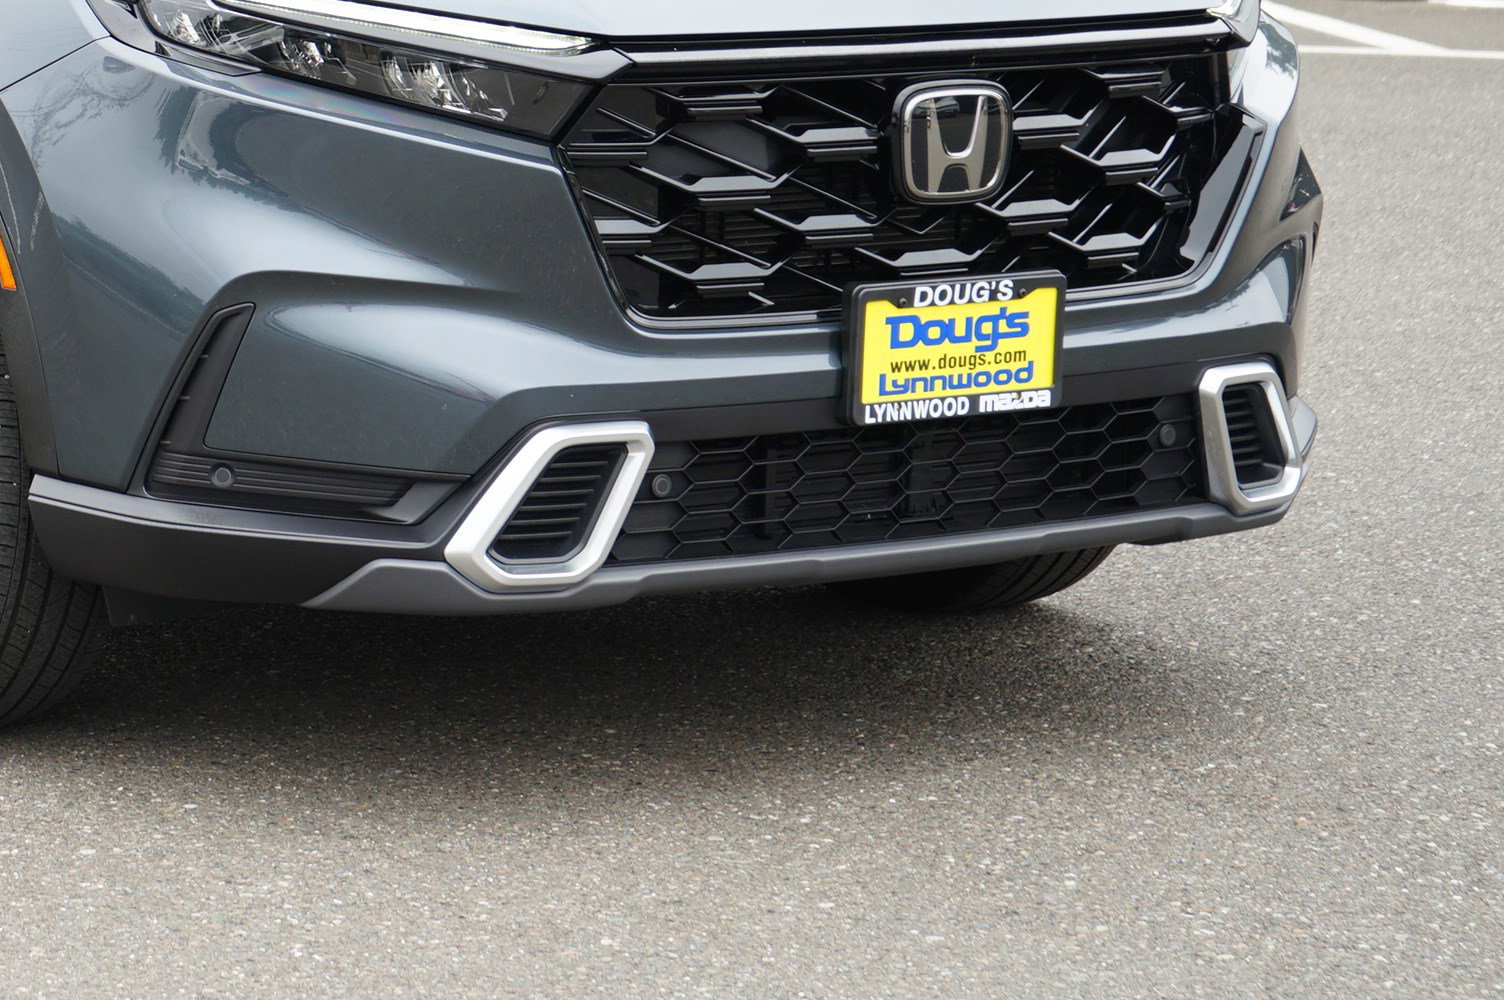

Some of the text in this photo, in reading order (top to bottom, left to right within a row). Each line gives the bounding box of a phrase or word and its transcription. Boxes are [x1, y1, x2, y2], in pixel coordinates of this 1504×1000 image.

[913, 279, 1014, 308] DOUG'S
[885, 307, 1030, 353] Doug's
[890, 350, 1027, 374] www.dougs.com
[879, 360, 1034, 396] Lynnwood
[865, 396, 970, 424] LYNNWOOD
